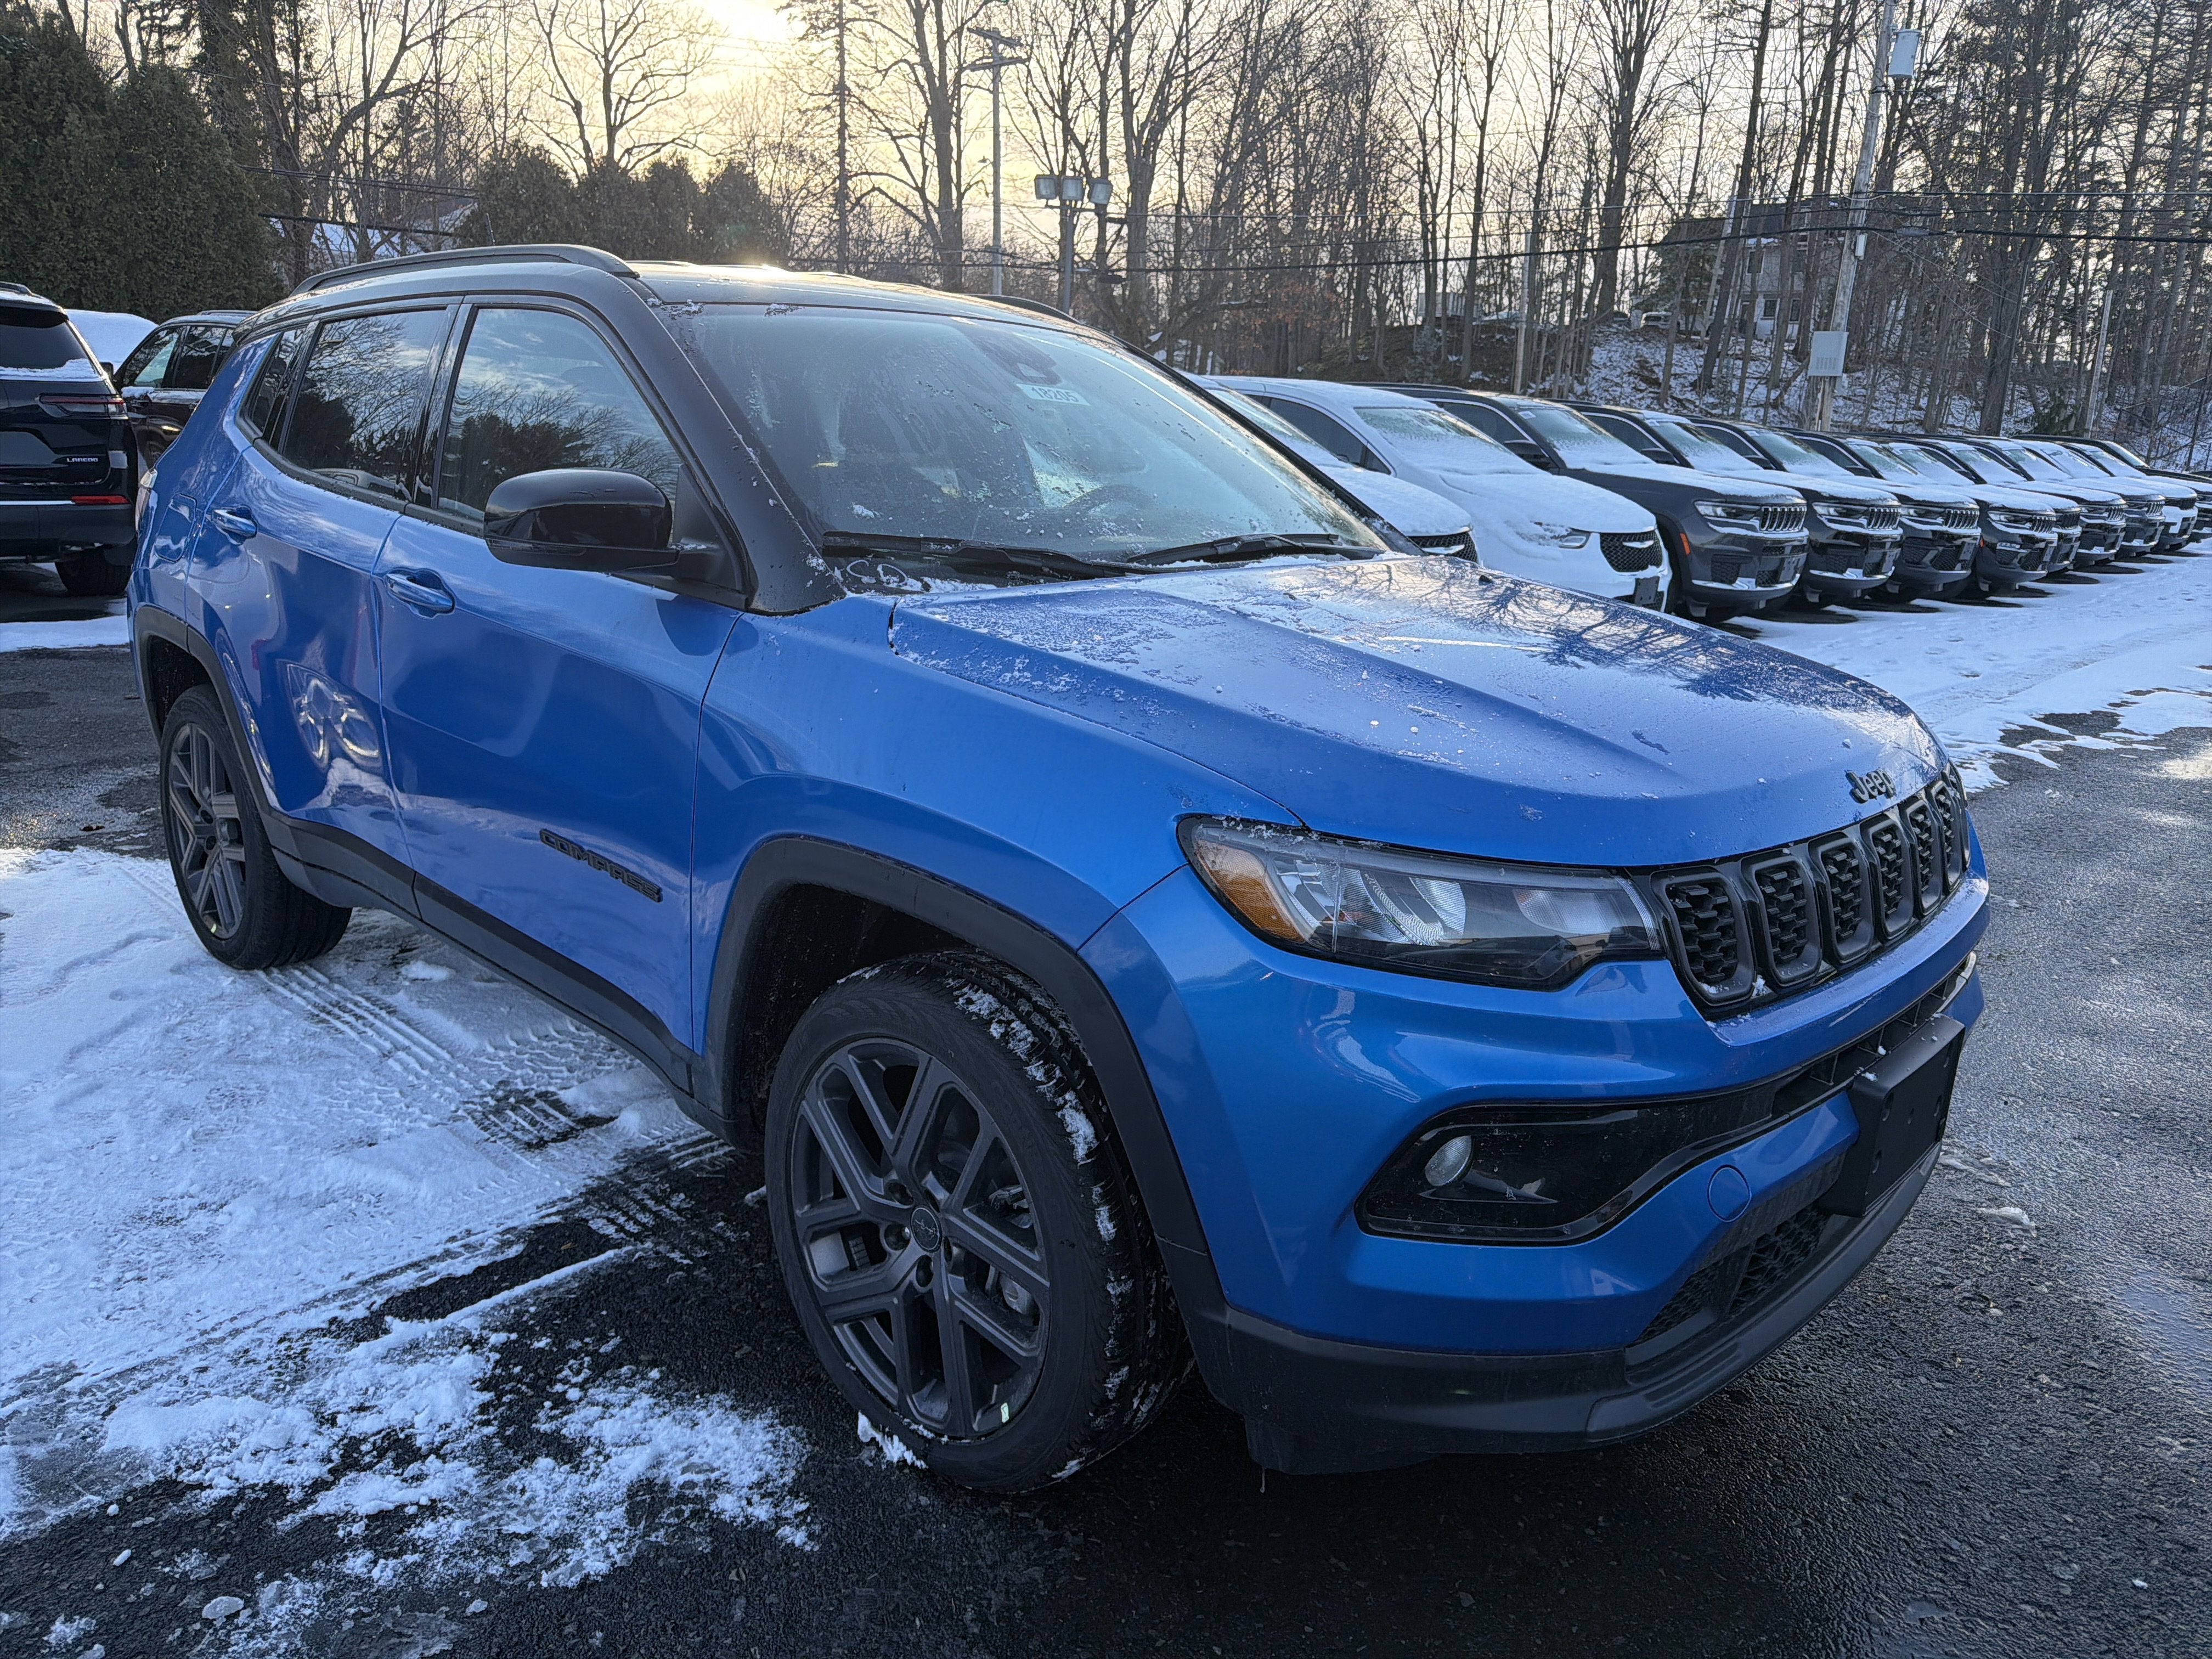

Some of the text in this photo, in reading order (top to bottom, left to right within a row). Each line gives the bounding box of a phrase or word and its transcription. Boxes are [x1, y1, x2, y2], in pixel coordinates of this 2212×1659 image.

[1031, 386, 1079, 403] 18205
[1844, 768, 1897, 804] Jeep
[539, 828, 663, 902] COMPASS
